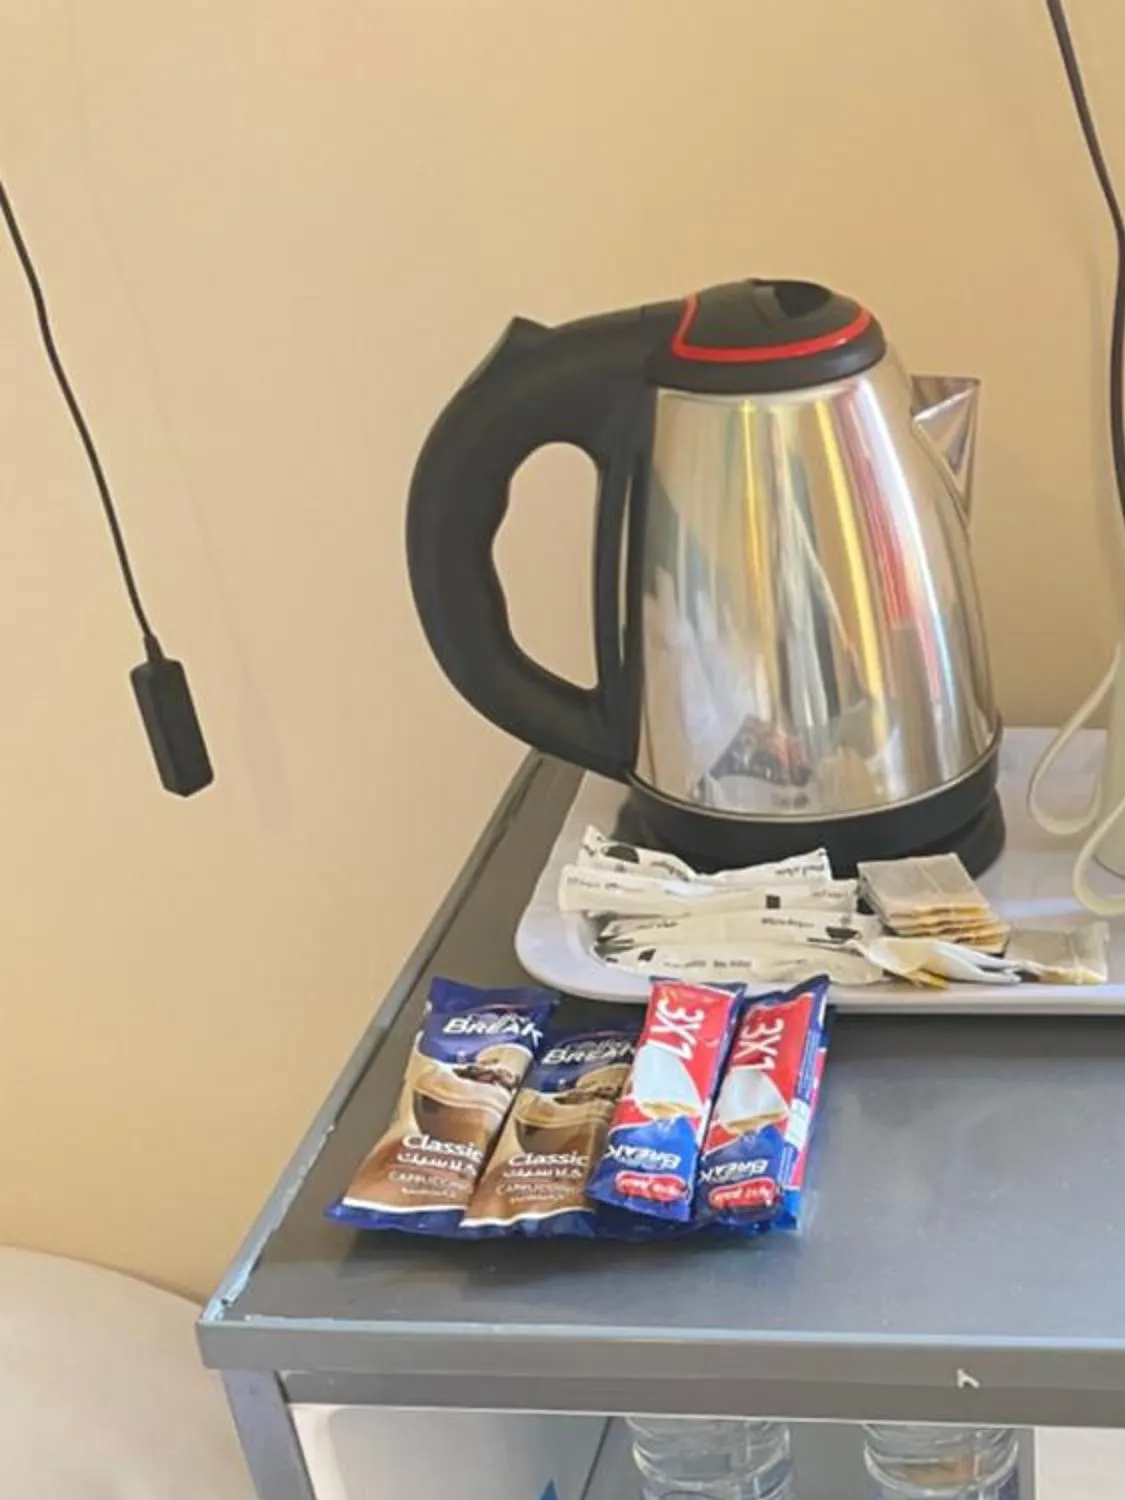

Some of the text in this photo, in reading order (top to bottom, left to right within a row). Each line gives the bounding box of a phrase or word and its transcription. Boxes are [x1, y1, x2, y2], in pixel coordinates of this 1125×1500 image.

[443, 1014, 544, 1048] BREAK
[649, 996, 705, 1060] 3X1
[731, 1018, 785, 1071] 3X1
[402, 1133, 484, 1164] Classic
[508, 1150, 590, 1167] Classic
